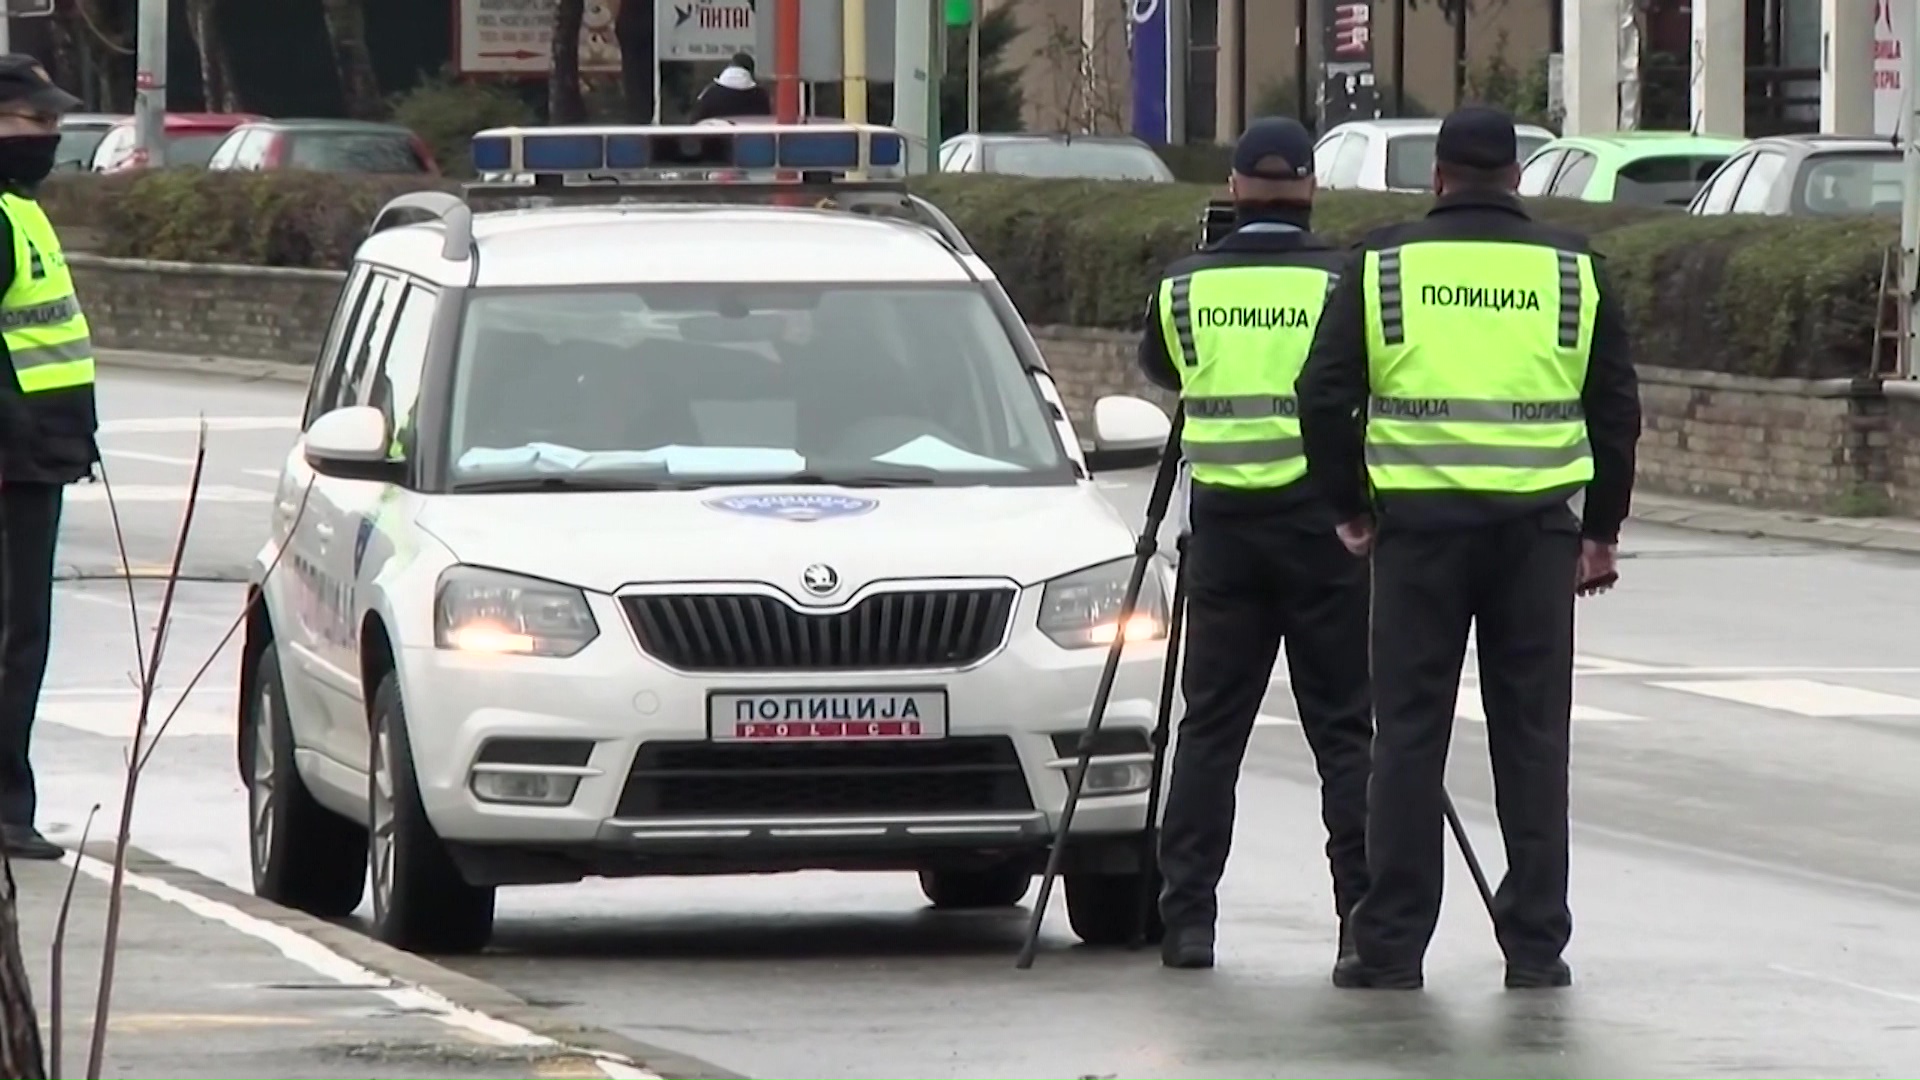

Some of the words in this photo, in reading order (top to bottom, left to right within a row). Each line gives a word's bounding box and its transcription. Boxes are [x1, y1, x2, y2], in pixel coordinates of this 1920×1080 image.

[1421, 284, 1540, 312] ПОЛИЦИЈА
[1198, 306, 1309, 330] ПОЛИЦИЈА
[736, 697, 919, 720] ПОЛИЦИЈА
[744, 723, 913, 737] POLICE
